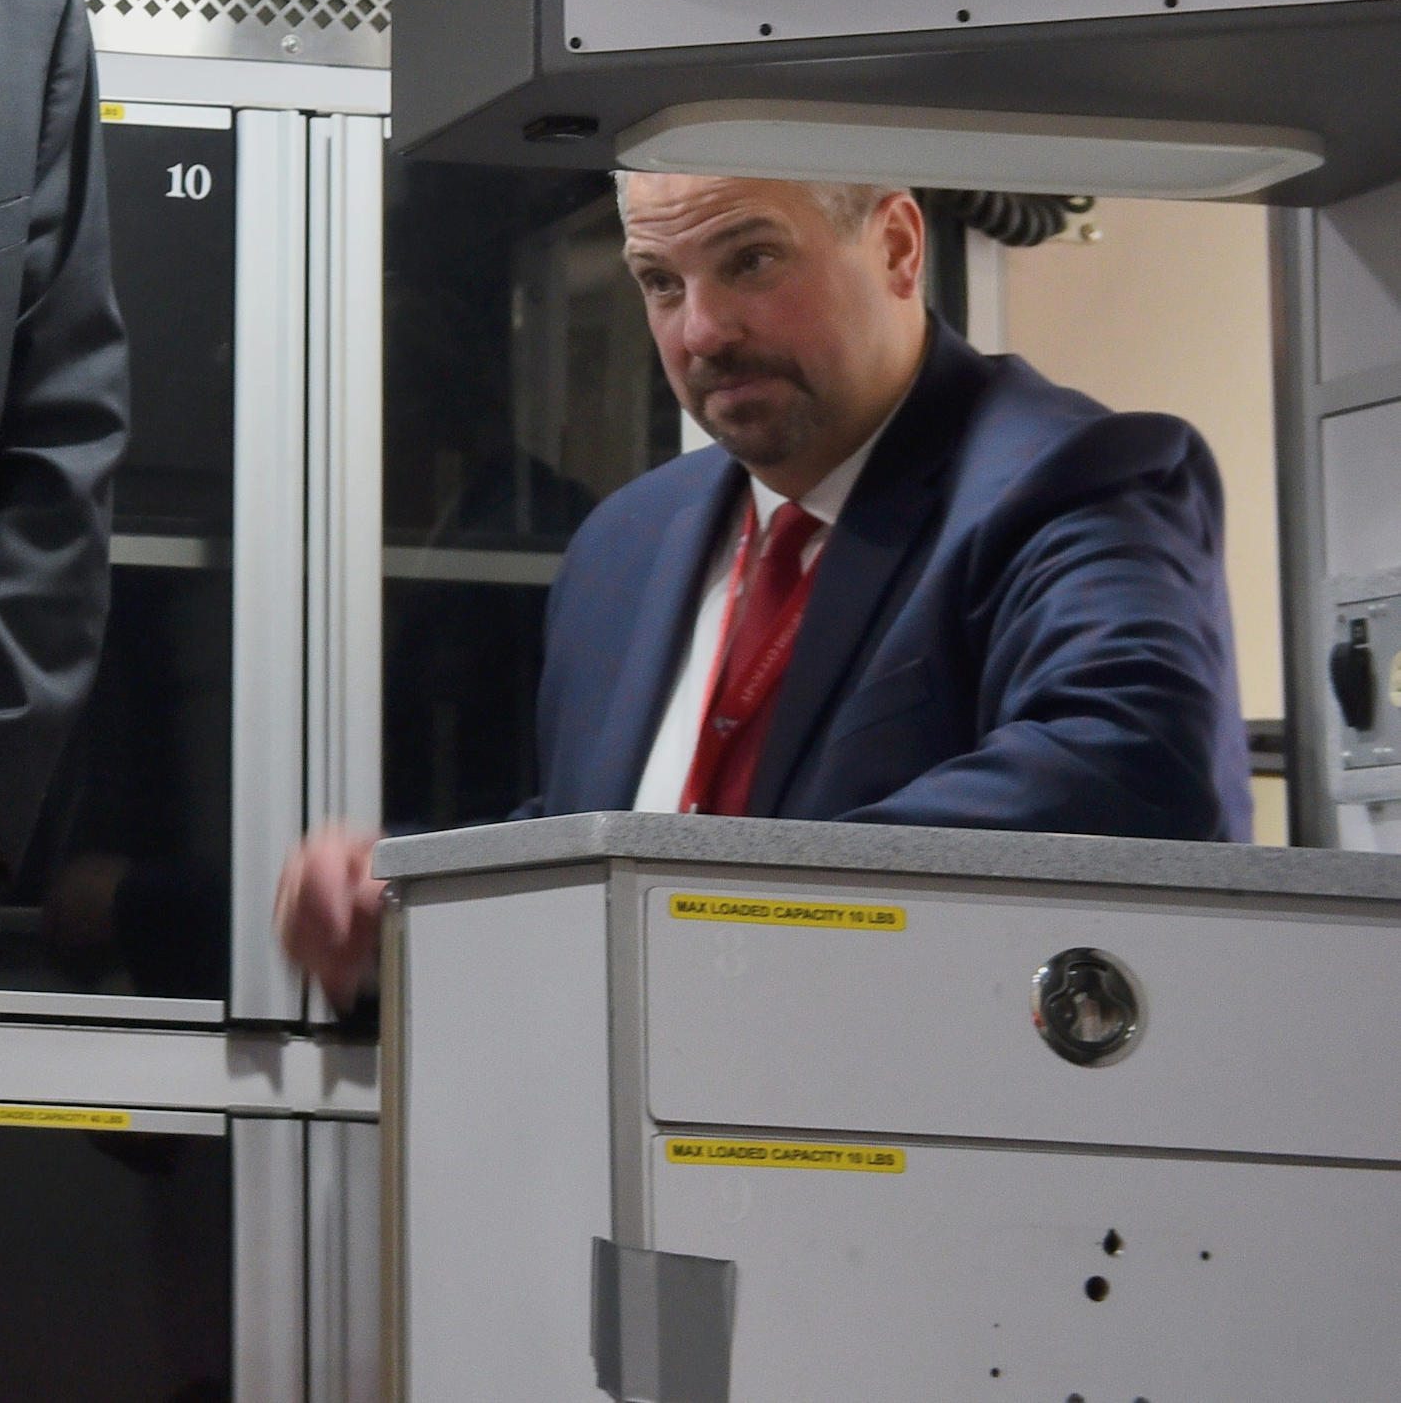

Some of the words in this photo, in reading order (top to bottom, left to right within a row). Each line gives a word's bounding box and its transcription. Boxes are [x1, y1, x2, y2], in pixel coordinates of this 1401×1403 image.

[164, 162, 212, 200] 10
[675, 900, 707, 914] MAX
[711, 902, 769, 918] LOADED
[774, 905, 844, 922] CAPACITY
[868, 911, 896, 925] LBS
[672, 1144, 703, 1157] MAX
[707, 1145, 768, 1161] LOADED
[771, 1147, 843, 1164] CAPACITY
[867, 1152, 896, 1166] LBS
